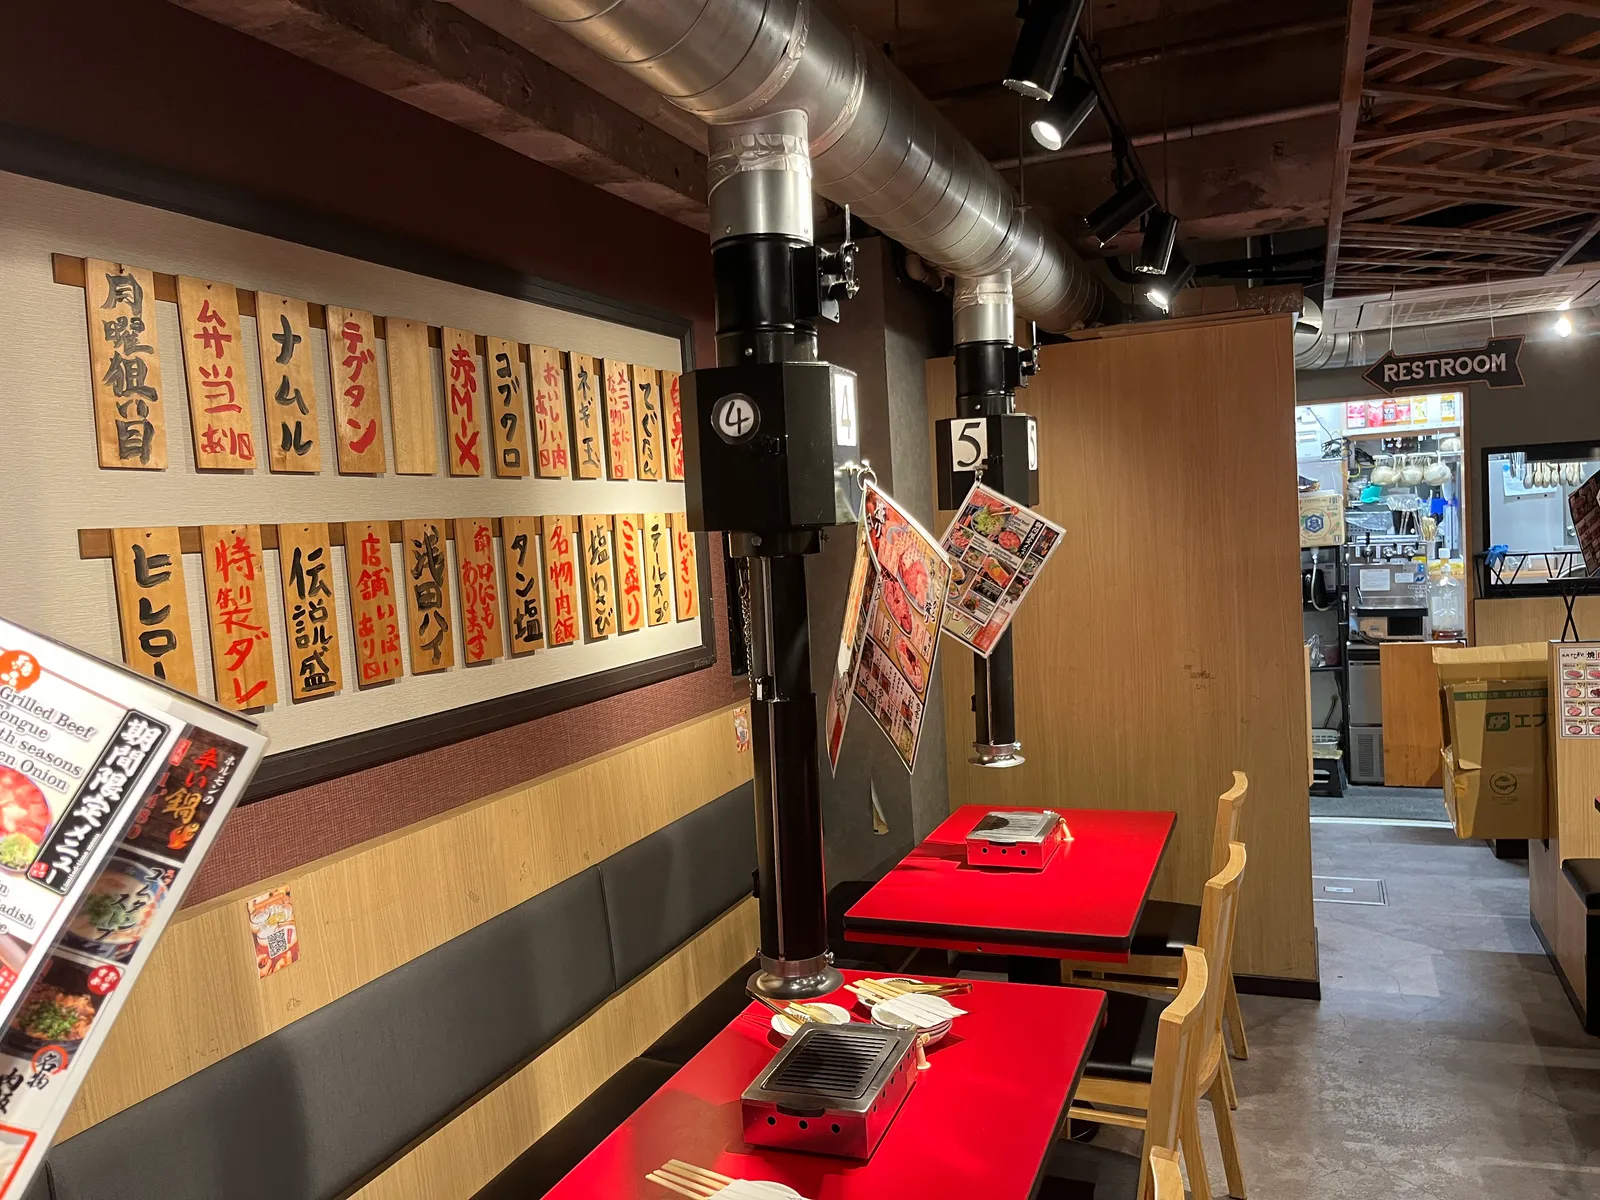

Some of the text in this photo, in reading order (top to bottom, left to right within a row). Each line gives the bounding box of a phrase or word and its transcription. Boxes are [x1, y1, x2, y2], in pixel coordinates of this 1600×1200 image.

[272, 314, 314, 457] ナムル
[496, 352, 521, 469] コブクロ
[1383, 353, 1508, 383] RESTROOM
[577, 365, 601, 469] ネギ玉
[638, 382, 658, 478] てぐたん
[725, 400, 750, 435] 4
[957, 421, 982, 467] 5
[356, 532, 391, 601] 店舗
[510, 533, 544, 643] タン塩
[549, 525, 576, 644] 名物肉飯
[588, 524, 613, 636] 塩わさび
[650, 523, 669, 623] テールスープ
[677, 531, 694, 616] にぎり
[214, 536, 269, 704] 特製ダレ
[289, 546, 338, 692] 伝説盛
[0, 686, 96, 740] Grilled Beef
[0, 703, 49, 740] ongue
[18, 739, 83, 777] seasons
[20, 759, 68, 792] Onion
[162, 746, 219, 825] 辛い鍋
[202, 755, 236, 805] ホルモンの
[45, 718, 163, 885] 期間限定メニュー
[26, 1052, 58, 1091] 名物
